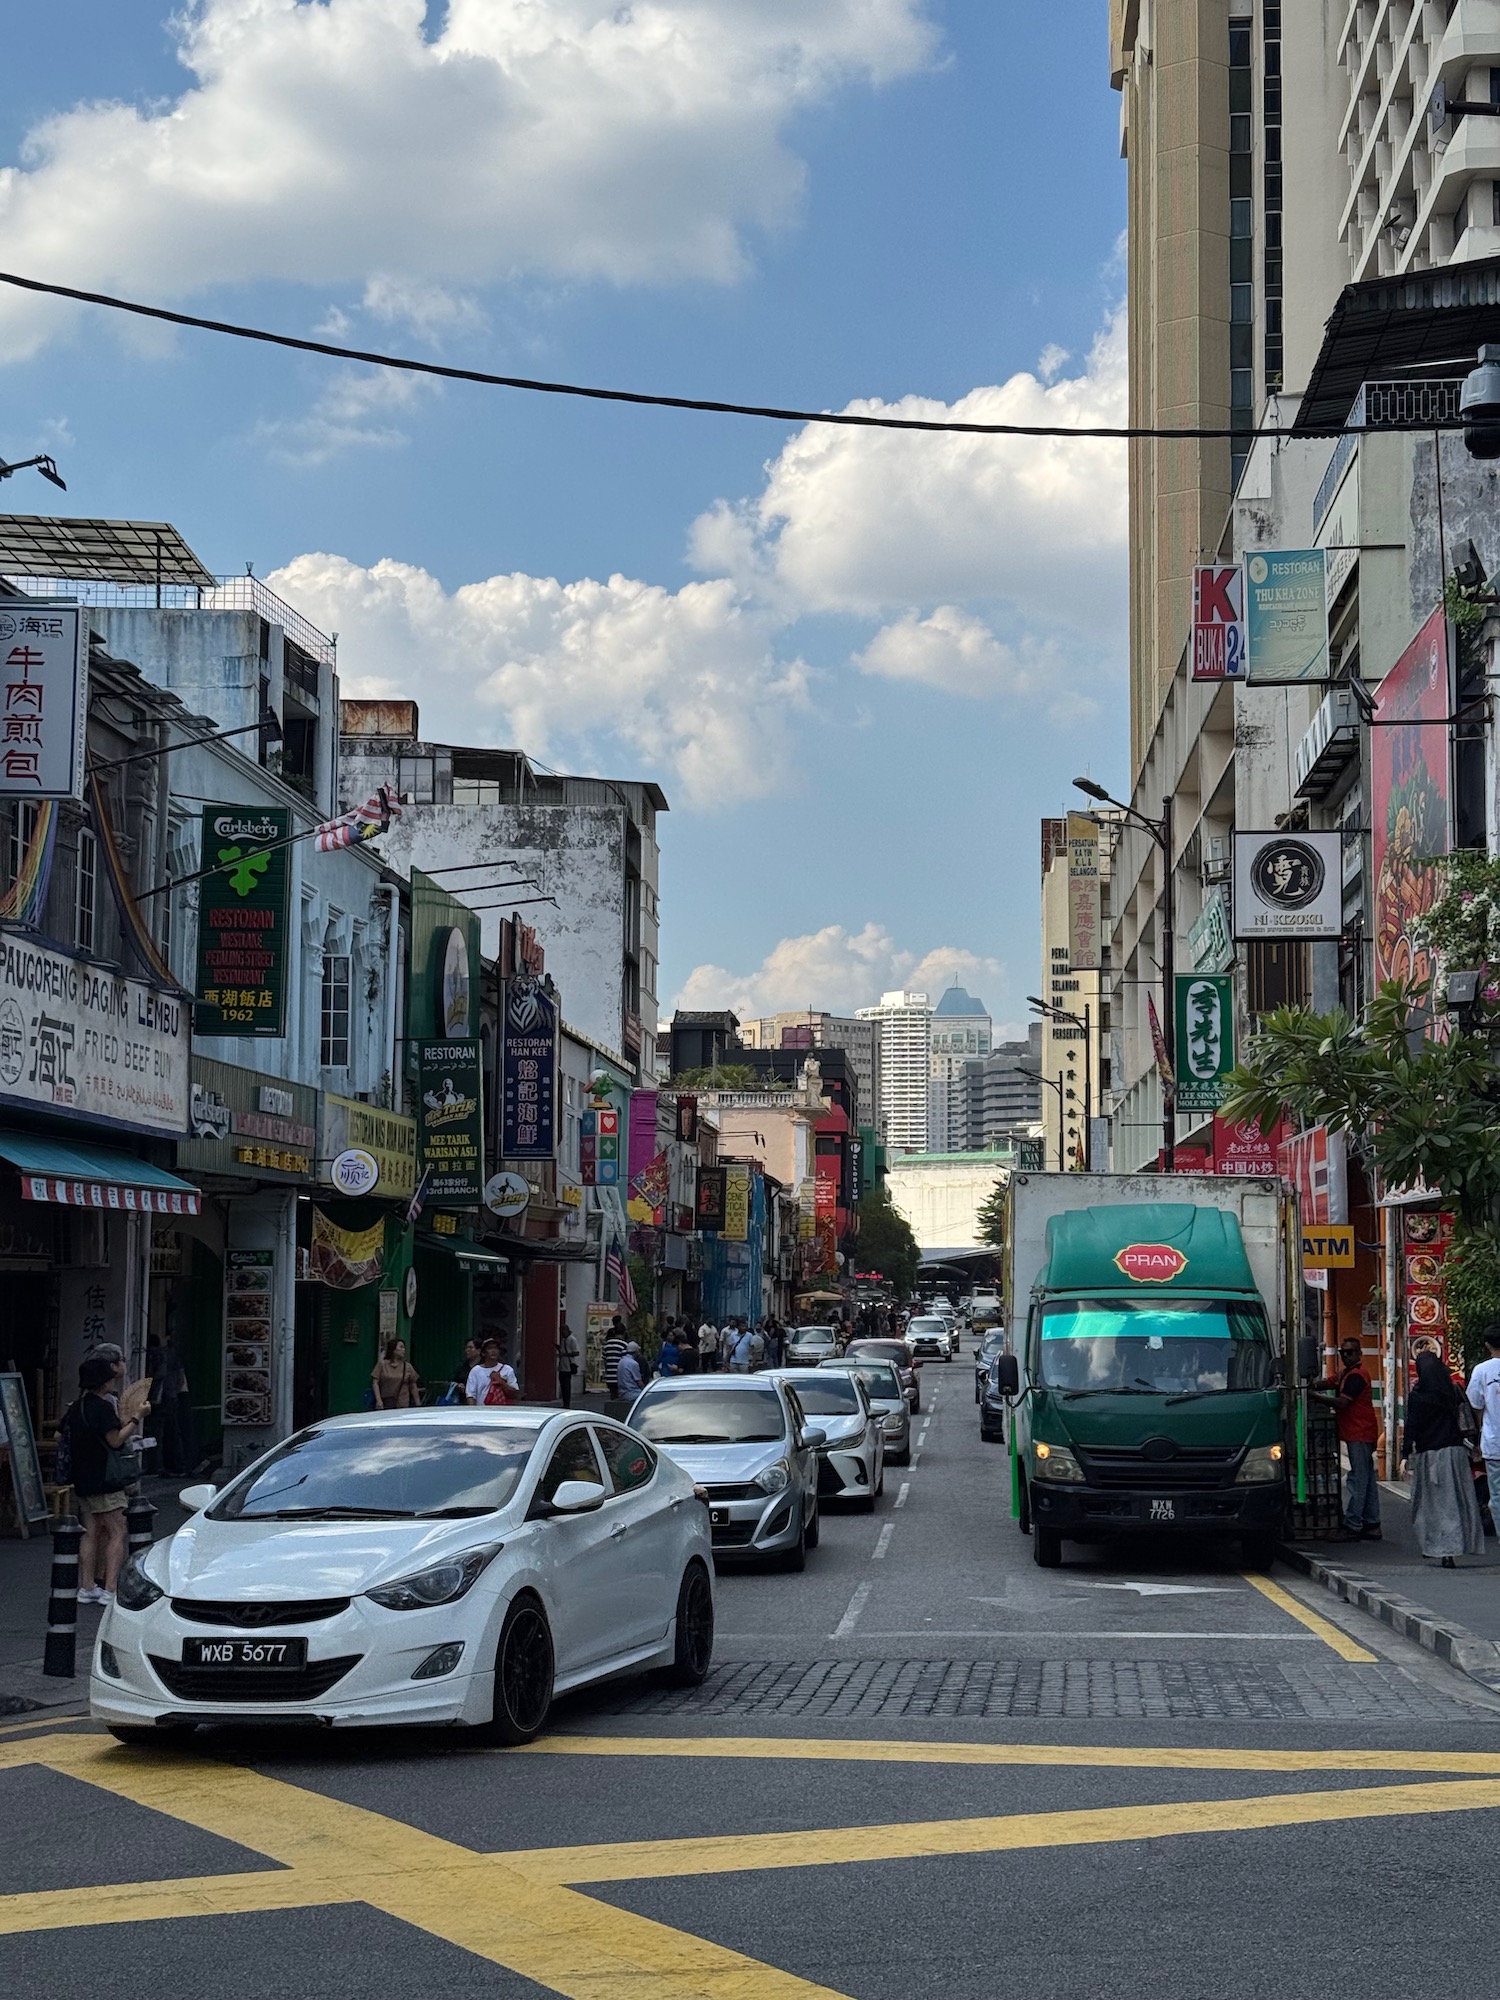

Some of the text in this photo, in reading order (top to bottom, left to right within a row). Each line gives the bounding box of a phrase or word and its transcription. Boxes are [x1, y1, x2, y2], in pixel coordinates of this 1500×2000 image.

[1272, 562, 1320, 575] RESTORAN
[1201, 569, 1244, 622] K
[1255, 587, 1320, 602] THU KHA ZONE
[1197, 628, 1224, 671] BUKA
[0, 645, 45, 787] 牛肉煎包
[213, 816, 278, 840] Carlsberg
[1070, 839, 1097, 848] PERSATUAN
[1070, 868, 1097, 876] SELANGOR
[209, 909, 275, 929] RESTORAN
[1273, 914, 1323, 925] KIZOKU
[1052, 947, 1069, 959] PERSA
[213, 970, 266, 985] RESTAURANT
[82, 972, 128, 1020] DAGING
[138, 993, 178, 1037] LEMBU
[204, 989, 273, 1008] 西湖飯店
[220, 1009, 254, 1021] 1962
[507, 1038, 553, 1048] RESTORAN
[85, 1029, 172, 1080] FRIED BEEF BUN
[424, 1046, 476, 1061] RESTORAN
[511, 1048, 549, 1057] HAN KEE
[1180, 1092, 1196, 1100] LEE
[430, 1134, 471, 1146] MEE TARIK
[423, 1146, 478, 1158] WARISAN ASLI
[1221, 1161, 1274, 1174] 中国小炒
[444, 1187, 478, 1195] BRANCH
[726, 1193, 743, 1201] CENE
[726, 1202, 746, 1210] PTICAL
[1303, 1238, 1349, 1256] ATM
[1125, 1253, 1178, 1267] PRAN
[83, 1284, 106, 1352] 传统
[1151, 1499, 1173, 1510] WXW
[1149, 1509, 1176, 1520] 7726
[201, 1644, 287, 1662] WXB 5677
